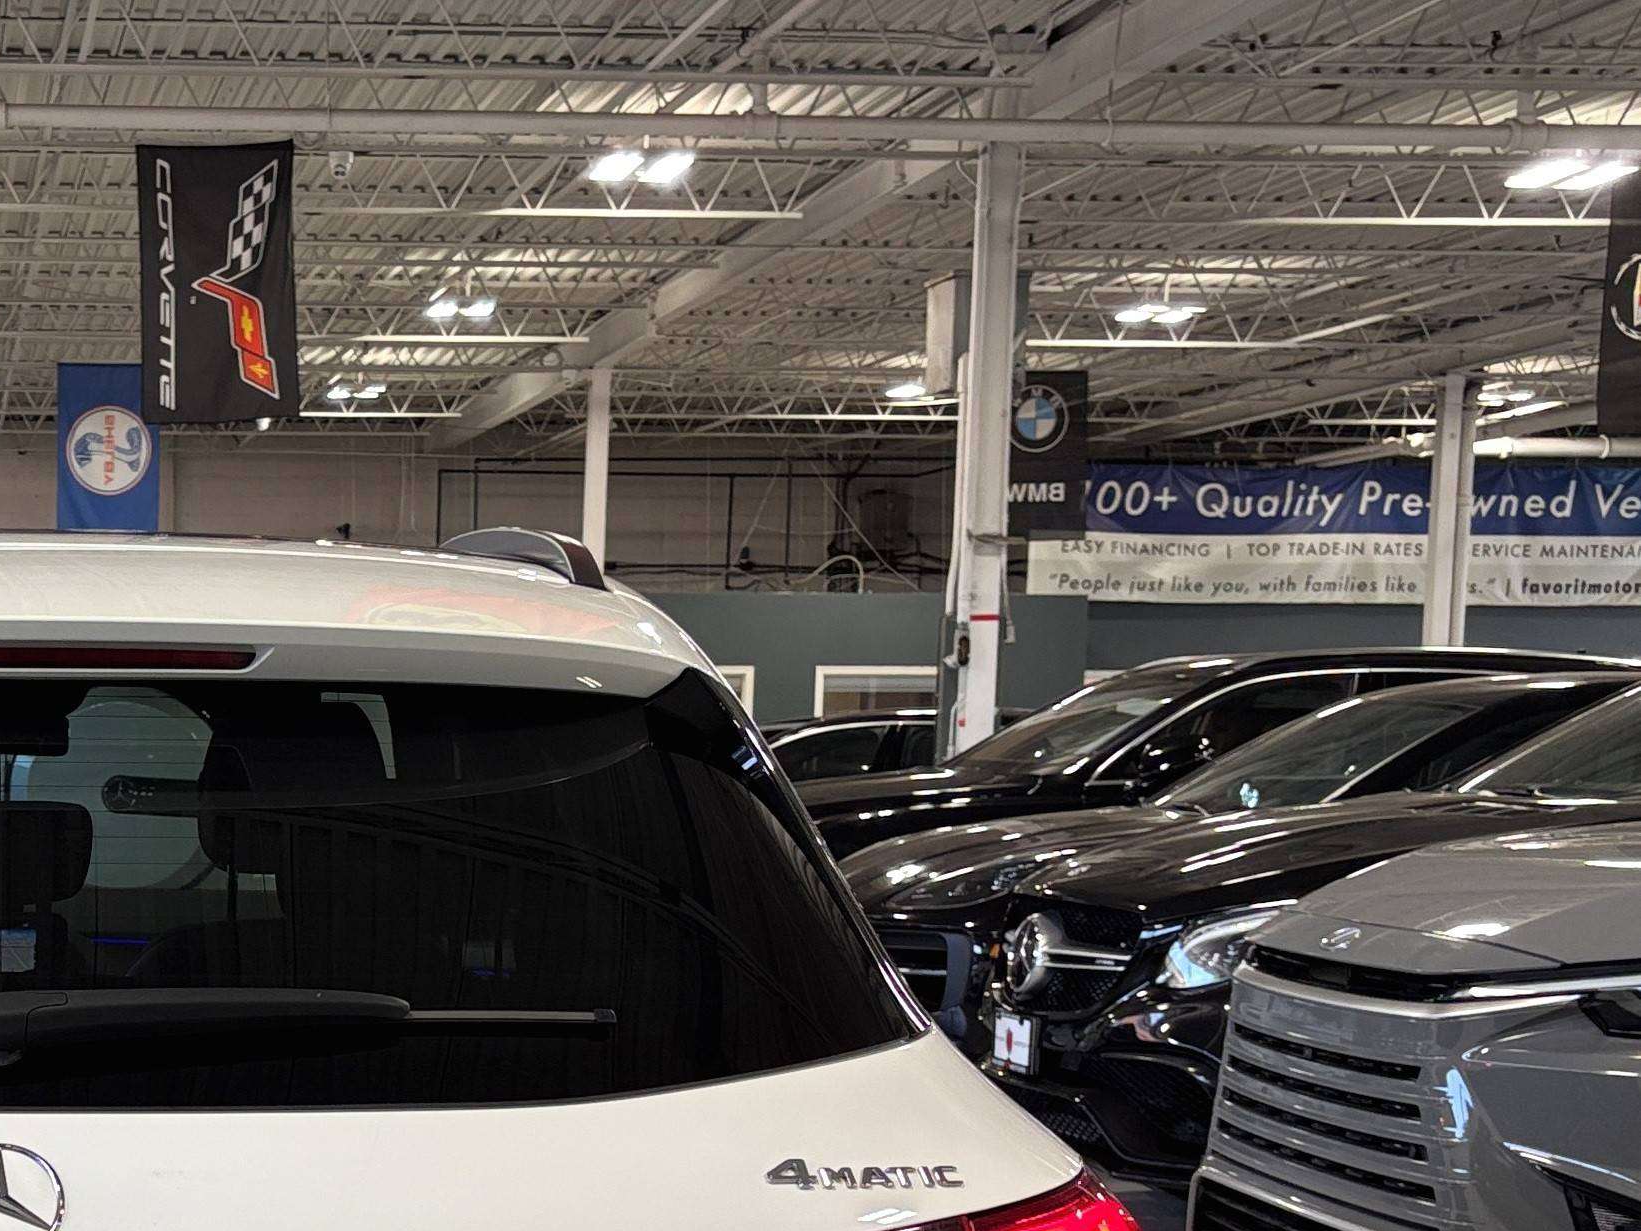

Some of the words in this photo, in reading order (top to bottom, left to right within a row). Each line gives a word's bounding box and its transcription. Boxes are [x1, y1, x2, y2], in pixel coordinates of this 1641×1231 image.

[156, 158, 176, 410] CORVETTE
[1195, 479, 1345, 527] Quality
[1594, 482, 1641, 519] Ve
[1060, 540, 1105, 554] EASY
[1110, 541, 1211, 557] FINANCING
[1247, 542, 1281, 558] TOP
[1288, 541, 1365, 557] TRADE-IN
[1373, 541, 1424, 558] RATES
[1471, 543, 1532, 558] ERVICE
[1128, 573, 1164, 594] just
[1170, 575, 1205, 593] like
[1210, 581, 1250, 596] you,
[1258, 575, 1298, 592] with
[1303, 574, 1378, 592] families
[1384, 575, 1418, 593] like
[765, 1158, 965, 1190] 4MATIC
